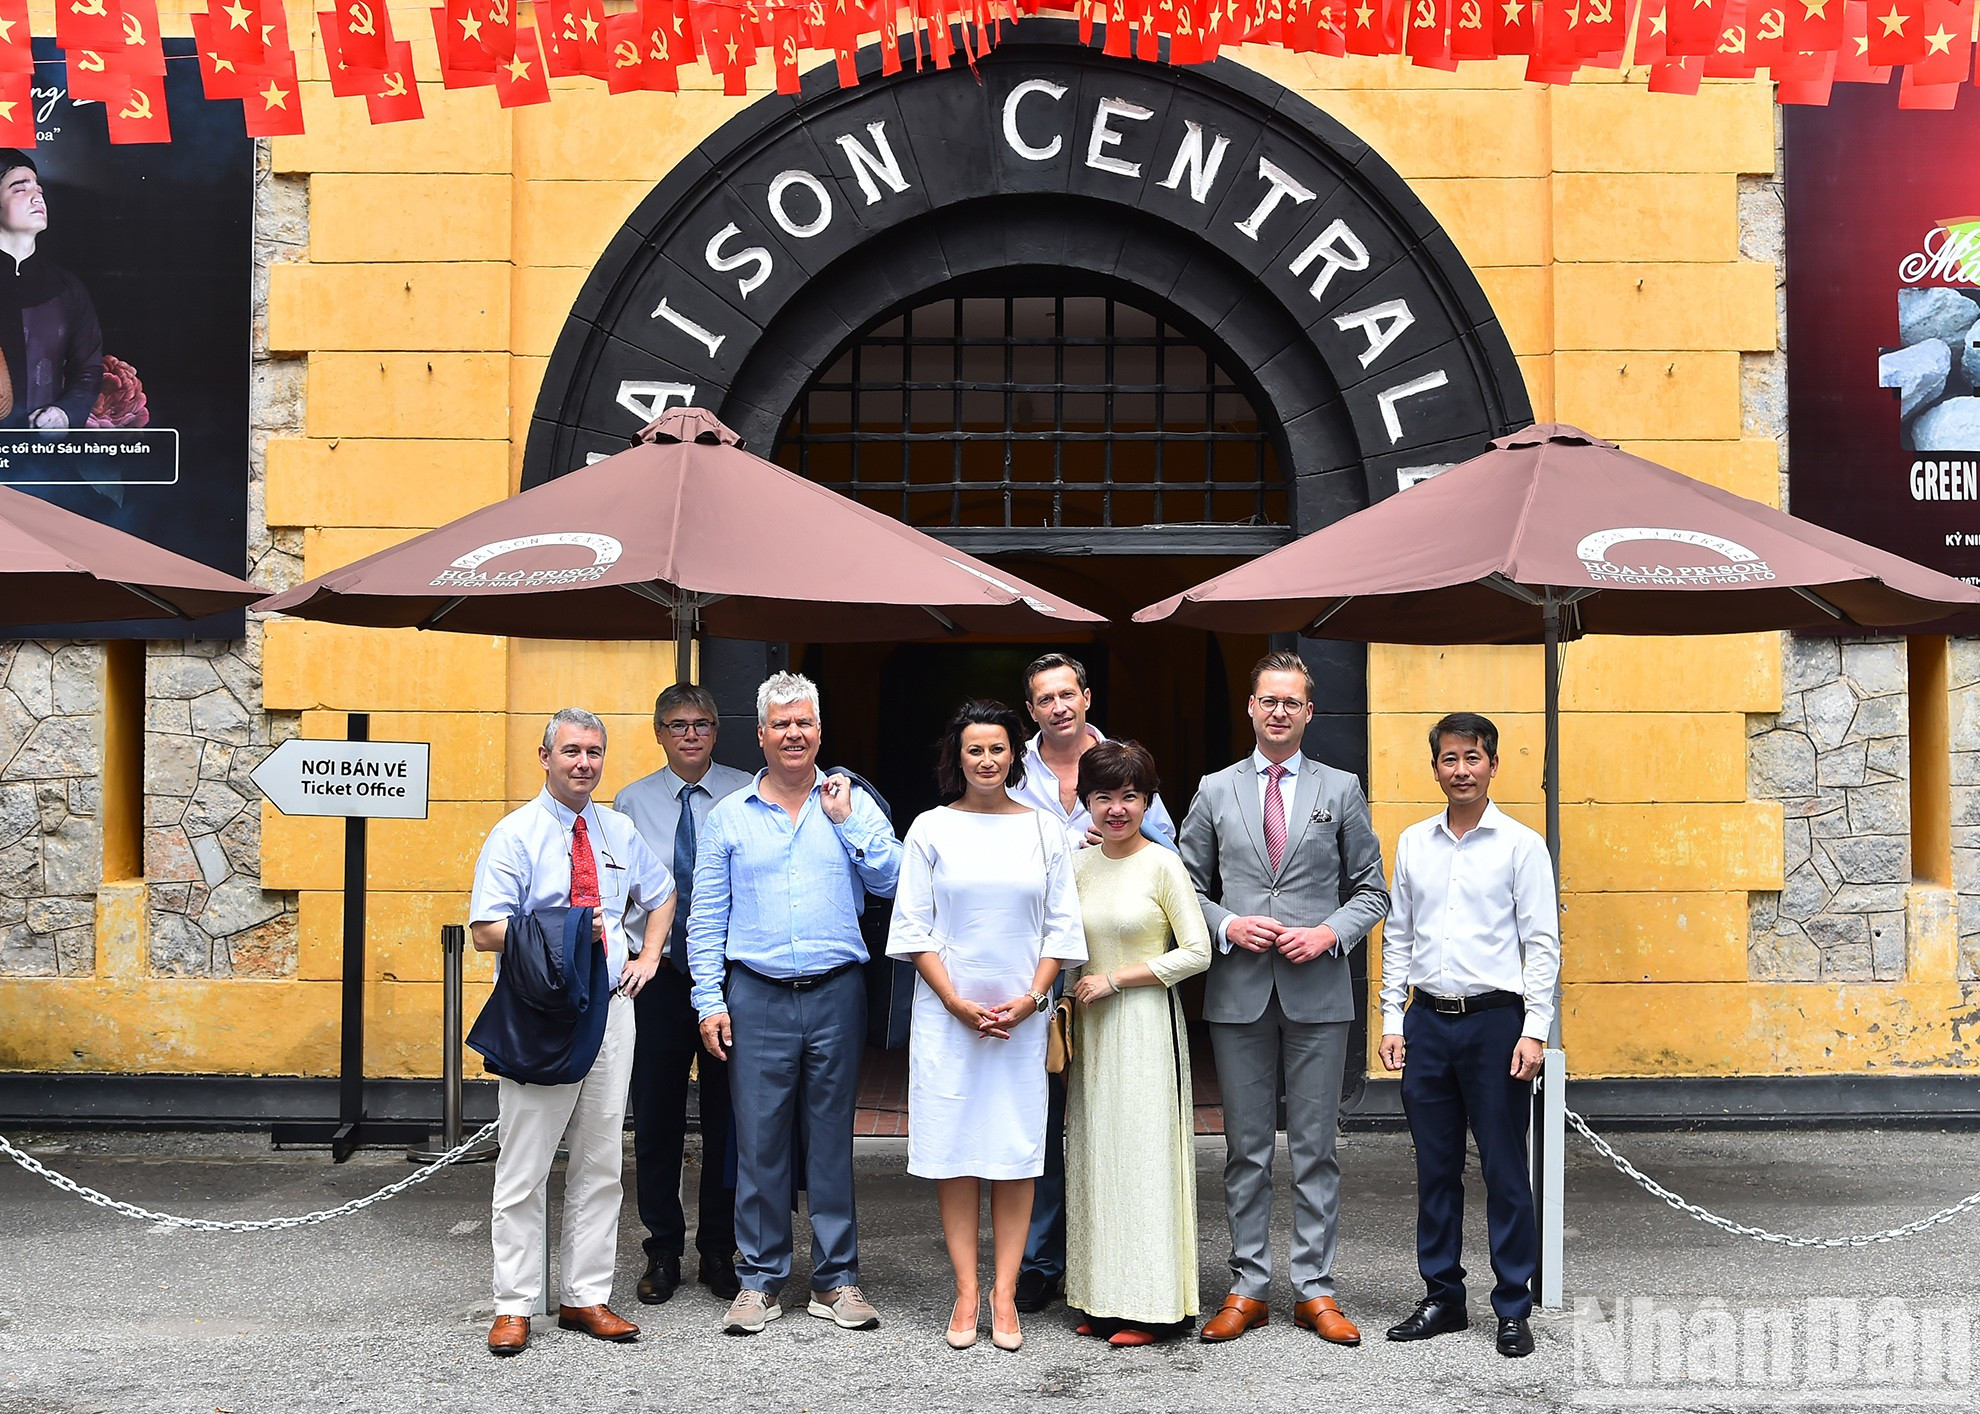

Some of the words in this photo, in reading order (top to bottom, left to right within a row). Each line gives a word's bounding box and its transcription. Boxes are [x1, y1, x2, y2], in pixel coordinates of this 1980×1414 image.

[30, 87, 66, 123] ng
[35, 127, 61, 141] oa”
[586, 121, 911, 466] AISON
[11, 442, 29, 454] tối
[31, 443, 55, 454] thứ
[57, 443, 82, 454] Sáu
[84, 443, 117, 456] hàng
[1910, 461, 1978, 501] GREEN
[1965, 534, 1980, 546] NI
[528, 564, 615, 580] PRISON
[1676, 561, 1769, 577] PRISON
[1590, 573, 1607, 582] DI
[302, 759, 335, 776] NƠI
[341, 759, 379, 777] BÁN
[384, 760, 407, 777] VÉ
[301, 781, 352, 796] Ticket
[356, 782, 406, 797] Office
